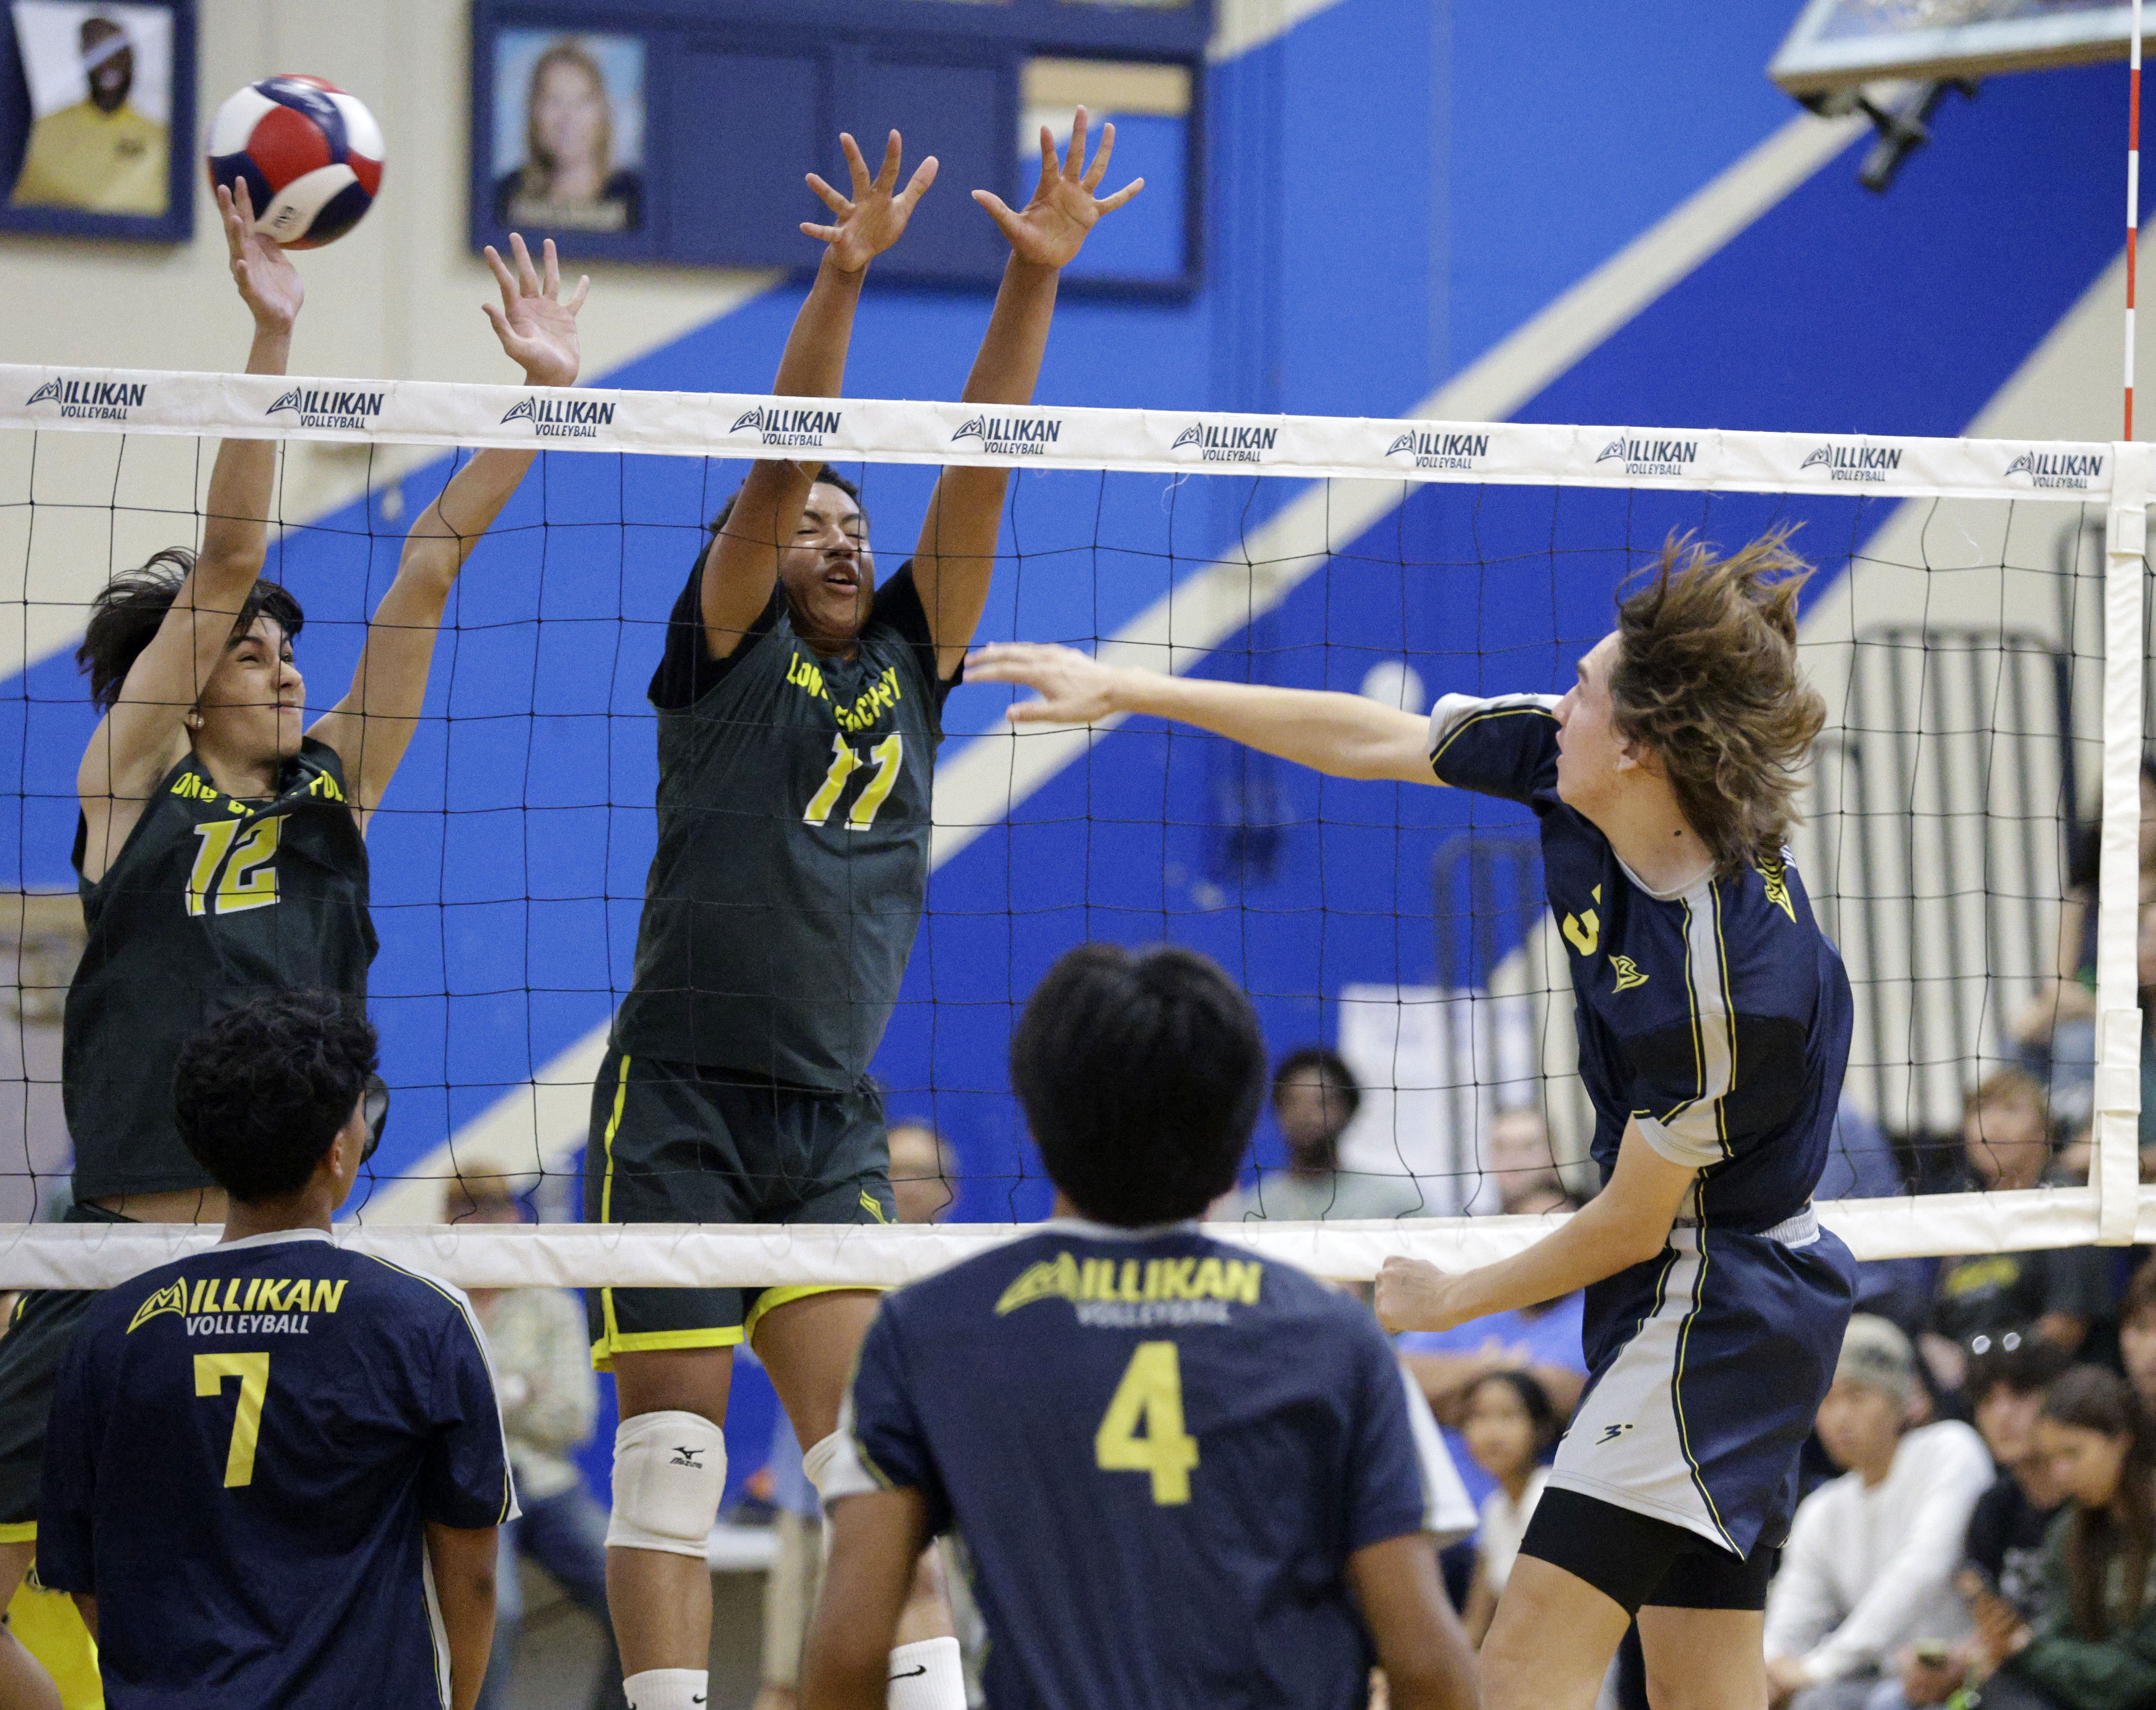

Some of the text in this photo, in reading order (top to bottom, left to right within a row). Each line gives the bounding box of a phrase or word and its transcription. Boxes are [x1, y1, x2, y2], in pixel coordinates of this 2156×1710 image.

[60, 406, 127, 420] VOLLEYBALL
[301, 415, 365, 429] VOLLEYBALL
[536, 424, 597, 437] VOLLEYBALL
[762, 433, 823, 446] VOLLEYBALL
[985, 442, 1044, 455] VOLLEYBALL
[1203, 449, 1261, 462] VOLLEYBALL
[1416, 456, 1472, 469] VOLLEYBALL
[1625, 463, 1682, 475] VOLLEYBALL
[1831, 469, 1885, 481] VOLLEYBALL
[2033, 476, 2087, 488] VOLLEYBALL
[186, 814, 291, 916] 12
[186, 1315, 309, 1336] VOLLEYBALL
[194, 1352, 269, 1488] 7
[1094, 1340, 1200, 1505] 4
